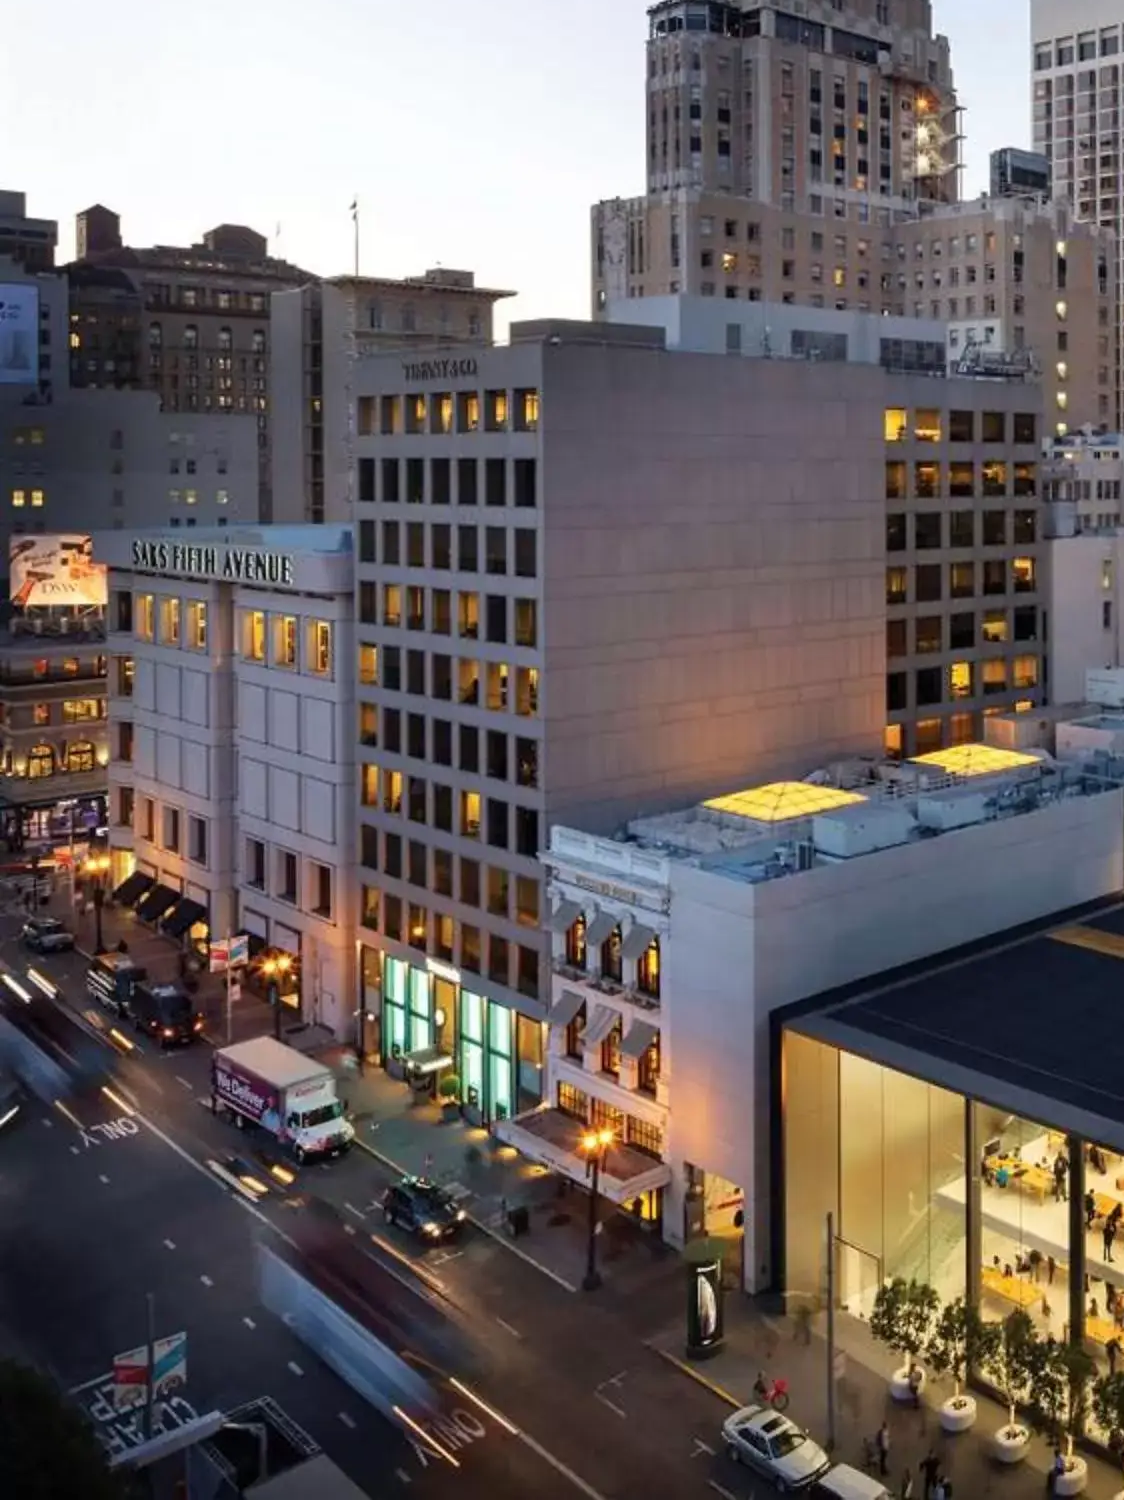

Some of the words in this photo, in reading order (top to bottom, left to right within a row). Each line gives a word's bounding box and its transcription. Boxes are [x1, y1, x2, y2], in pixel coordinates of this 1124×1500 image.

[132, 540, 168, 569] SAKS
[172, 544, 217, 574] FIFTH
[223, 549, 294, 586] AVENUE
[79, 1117, 139, 1148] ONLY
